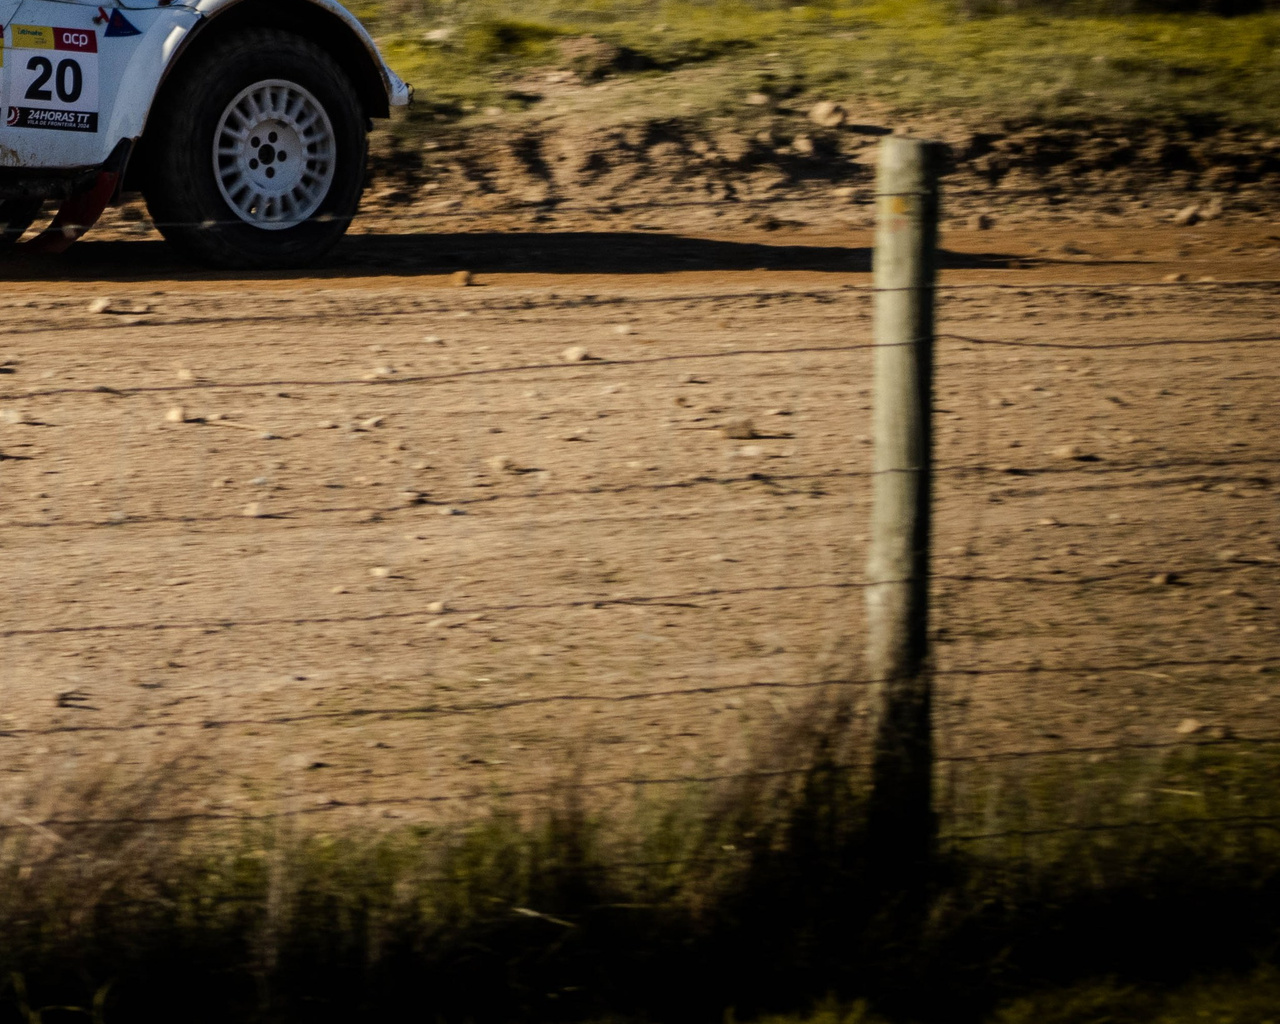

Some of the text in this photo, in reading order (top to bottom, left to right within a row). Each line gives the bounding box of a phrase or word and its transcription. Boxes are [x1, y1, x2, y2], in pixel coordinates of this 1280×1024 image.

[62, 32, 88, 47] acp
[24, 56, 83, 103] 20
[27, 109, 90, 123] 24HORAS TT
